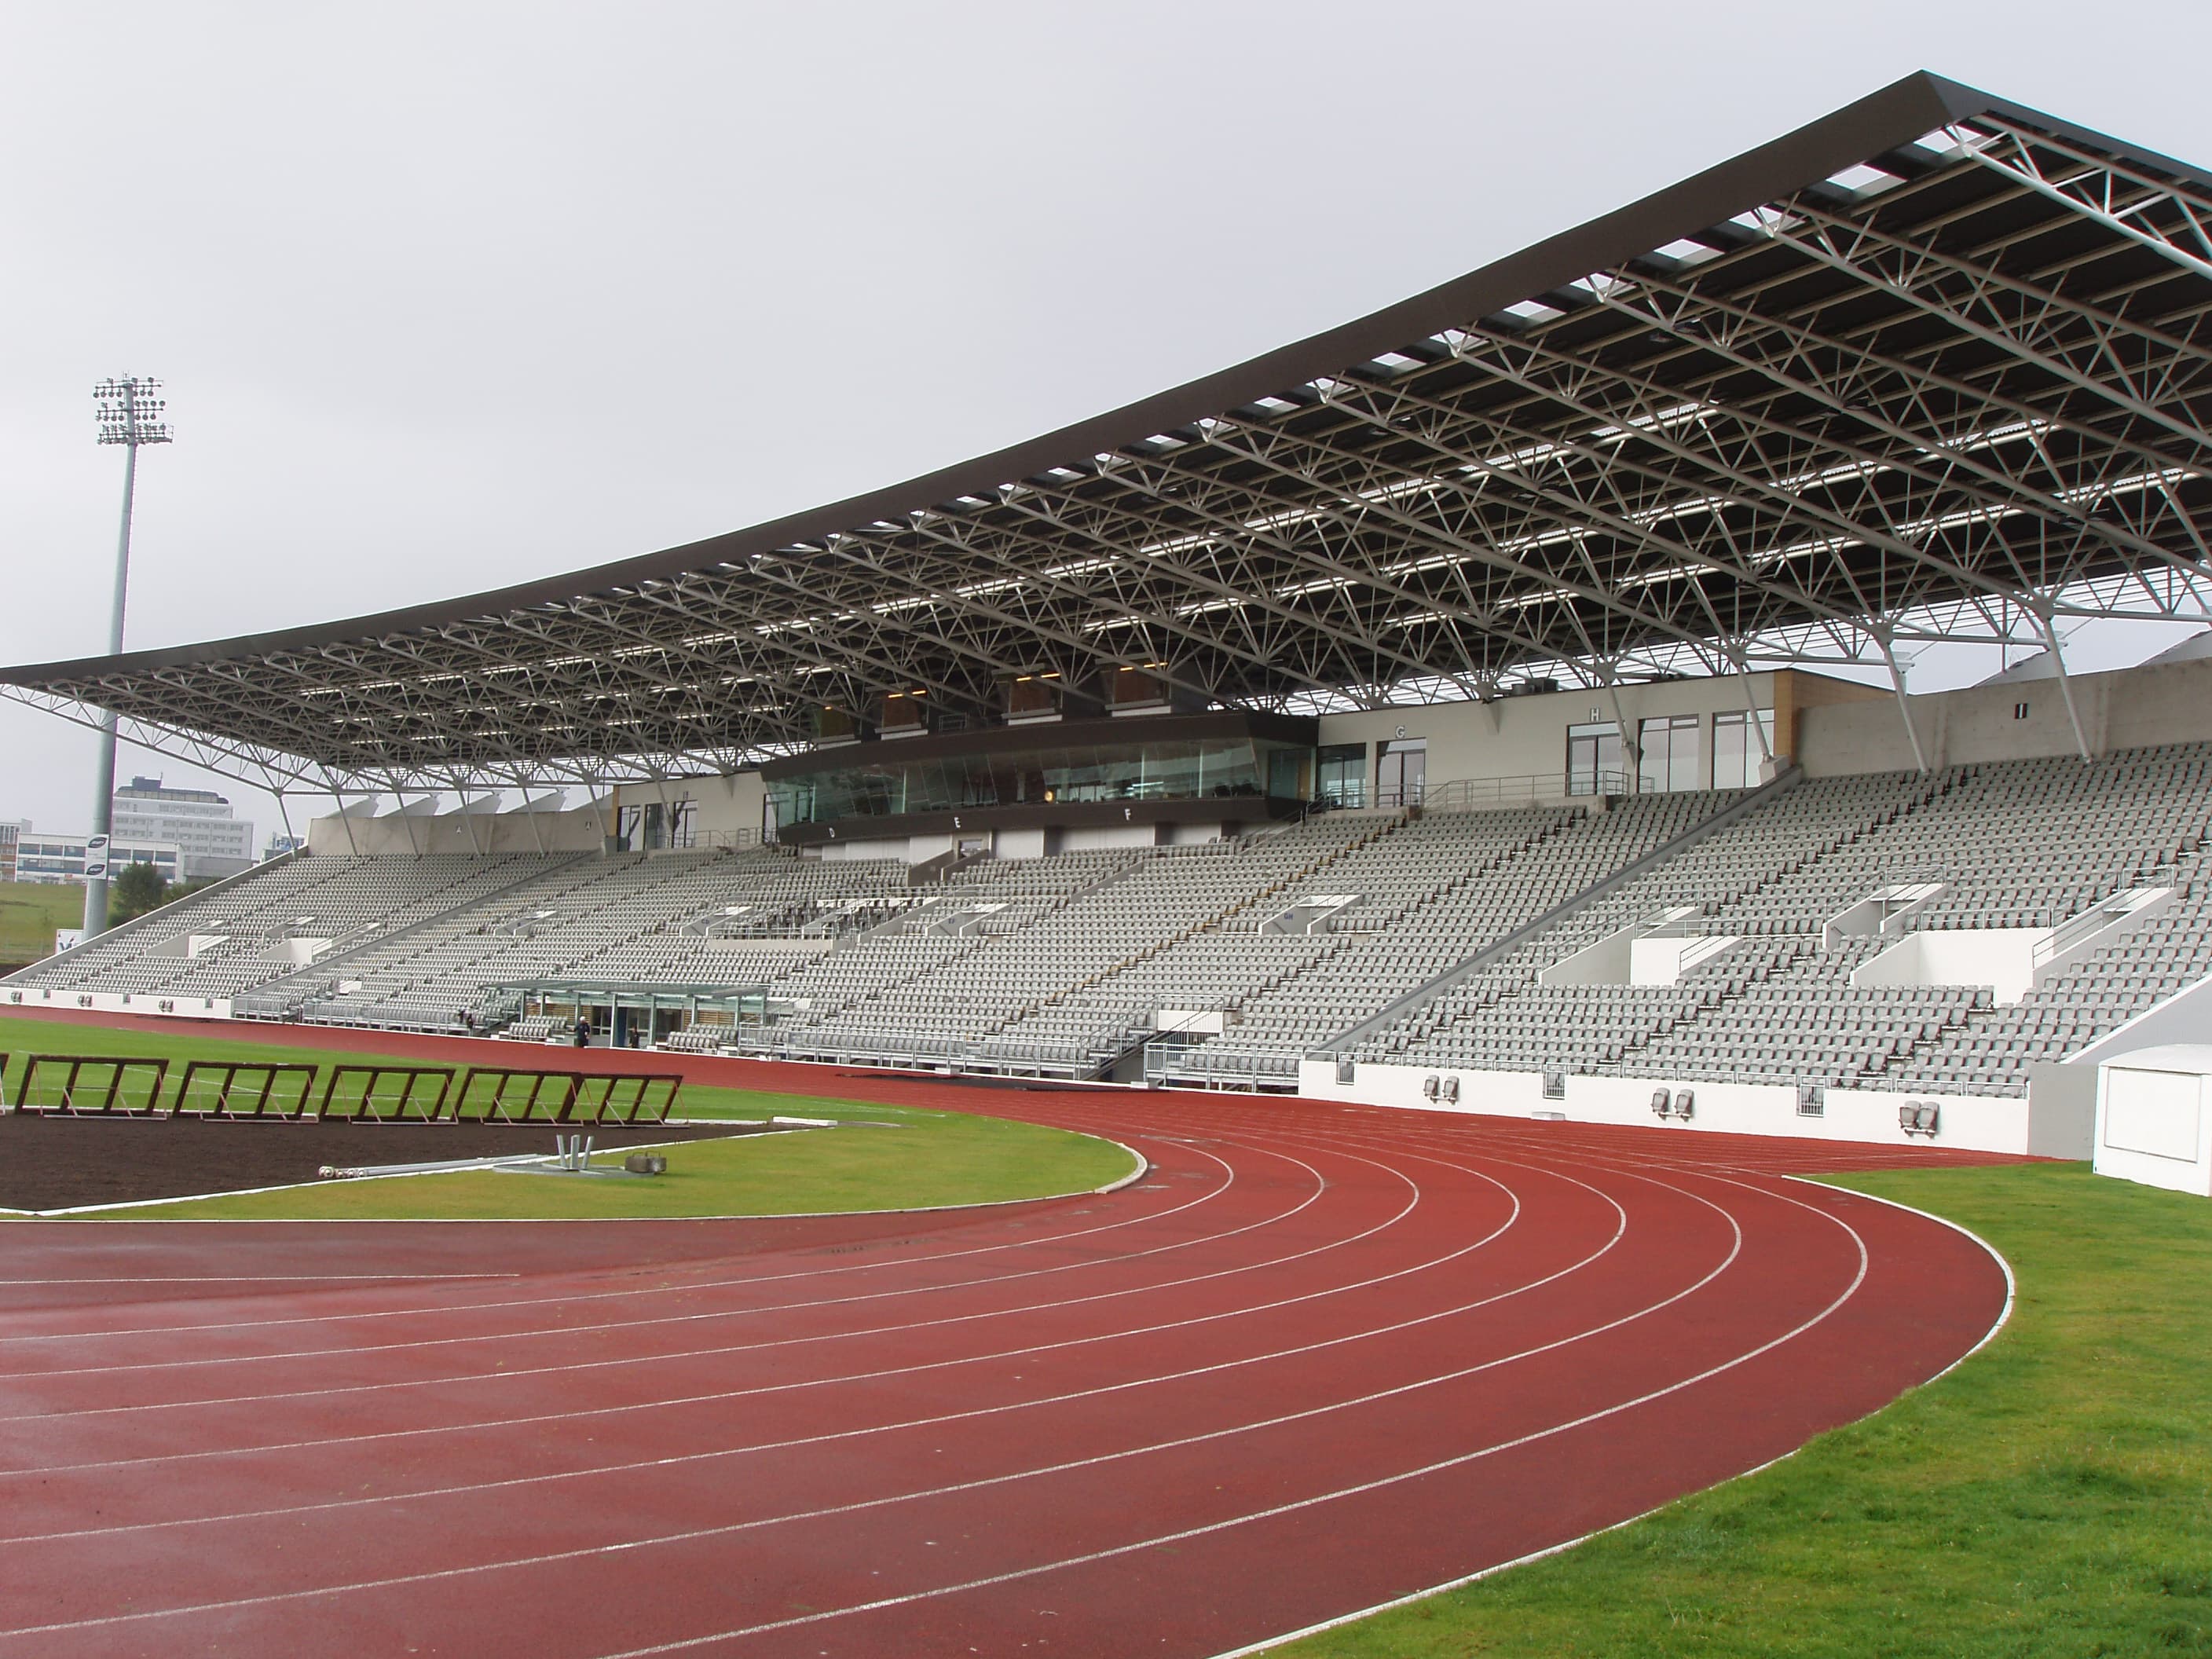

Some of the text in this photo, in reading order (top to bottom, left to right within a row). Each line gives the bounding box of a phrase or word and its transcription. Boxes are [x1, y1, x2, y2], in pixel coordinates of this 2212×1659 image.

[1591, 707, 1599, 722] H
[1396, 726, 1405, 738] G
[1124, 808, 1131, 821] F
[954, 816, 961, 828] E
